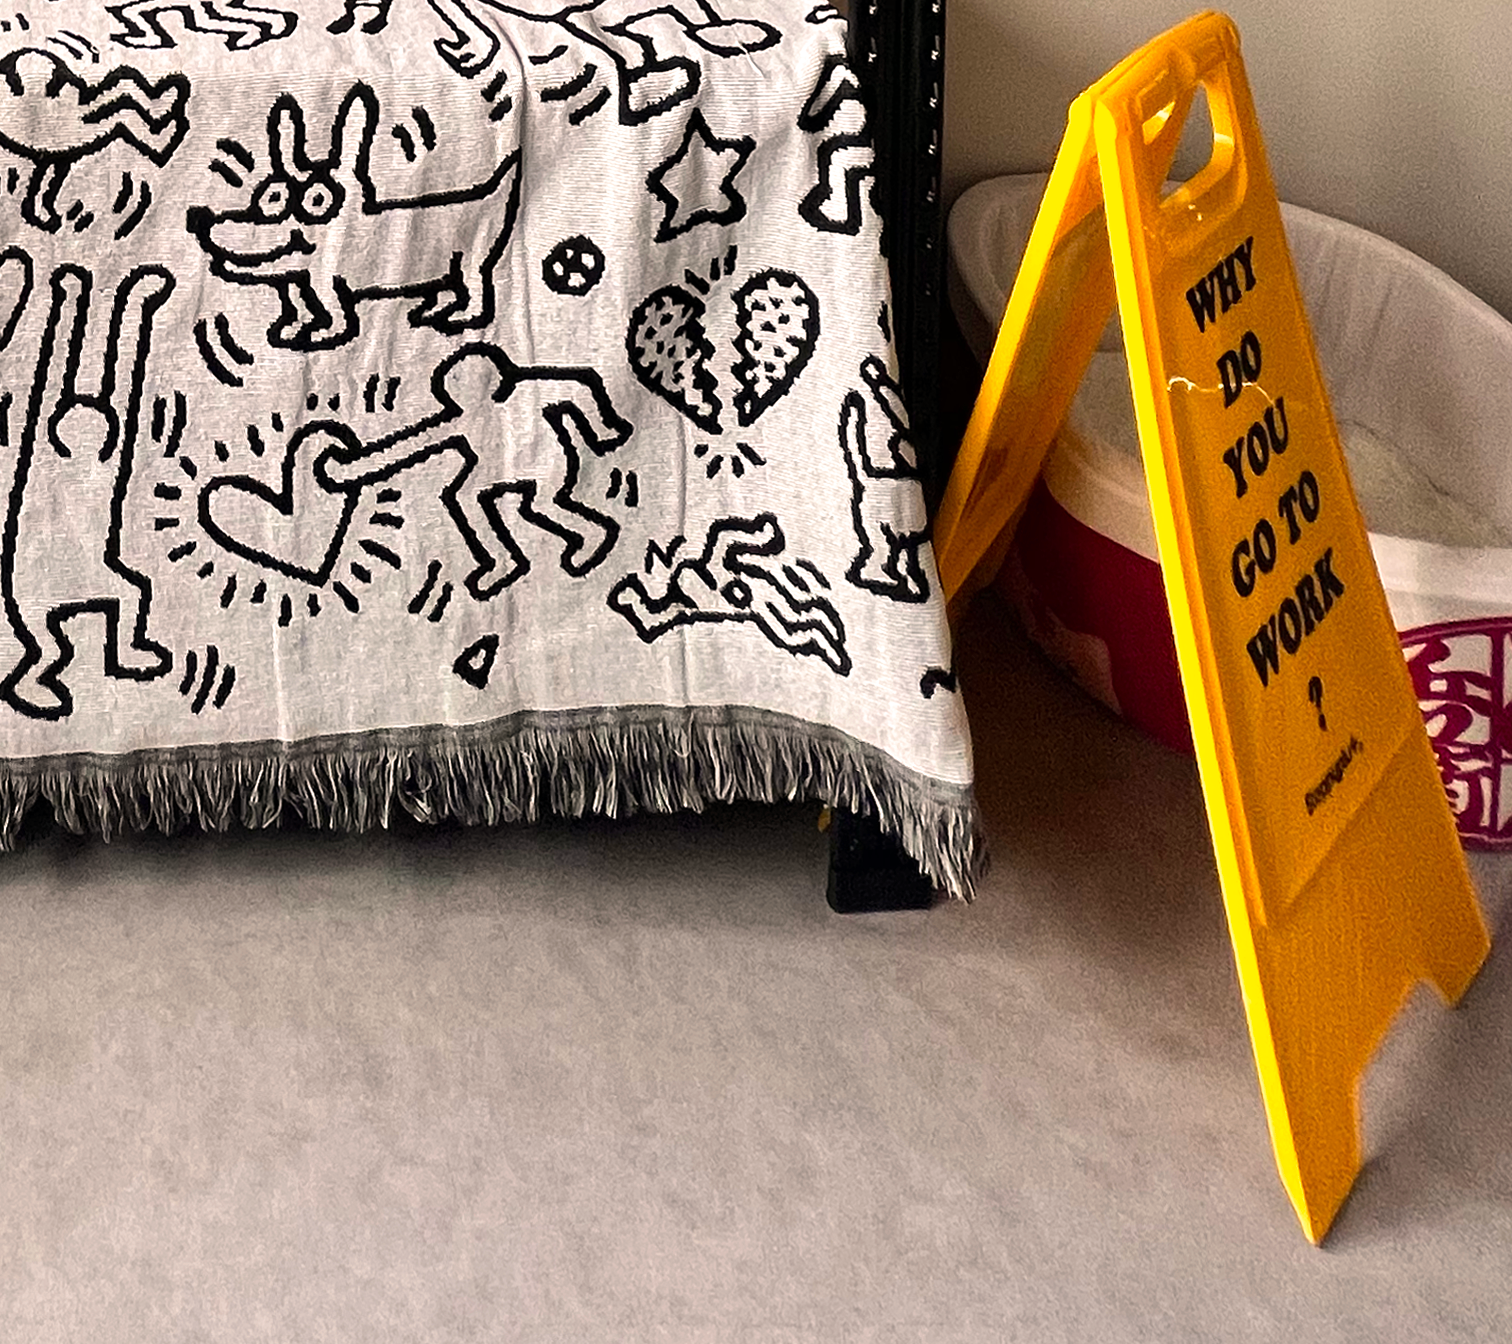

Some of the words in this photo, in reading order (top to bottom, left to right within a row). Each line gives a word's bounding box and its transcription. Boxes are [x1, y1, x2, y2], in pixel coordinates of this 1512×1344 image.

[1186, 237, 1257, 334] WHY
[1217, 330, 1262, 409] DO
[1222, 397, 1289, 499] YOU
[1230, 515, 1277, 599] GO
[1277, 468, 1321, 546] TO
[1246, 547, 1346, 689] WORK
[1307, 675, 1327, 732] ?
